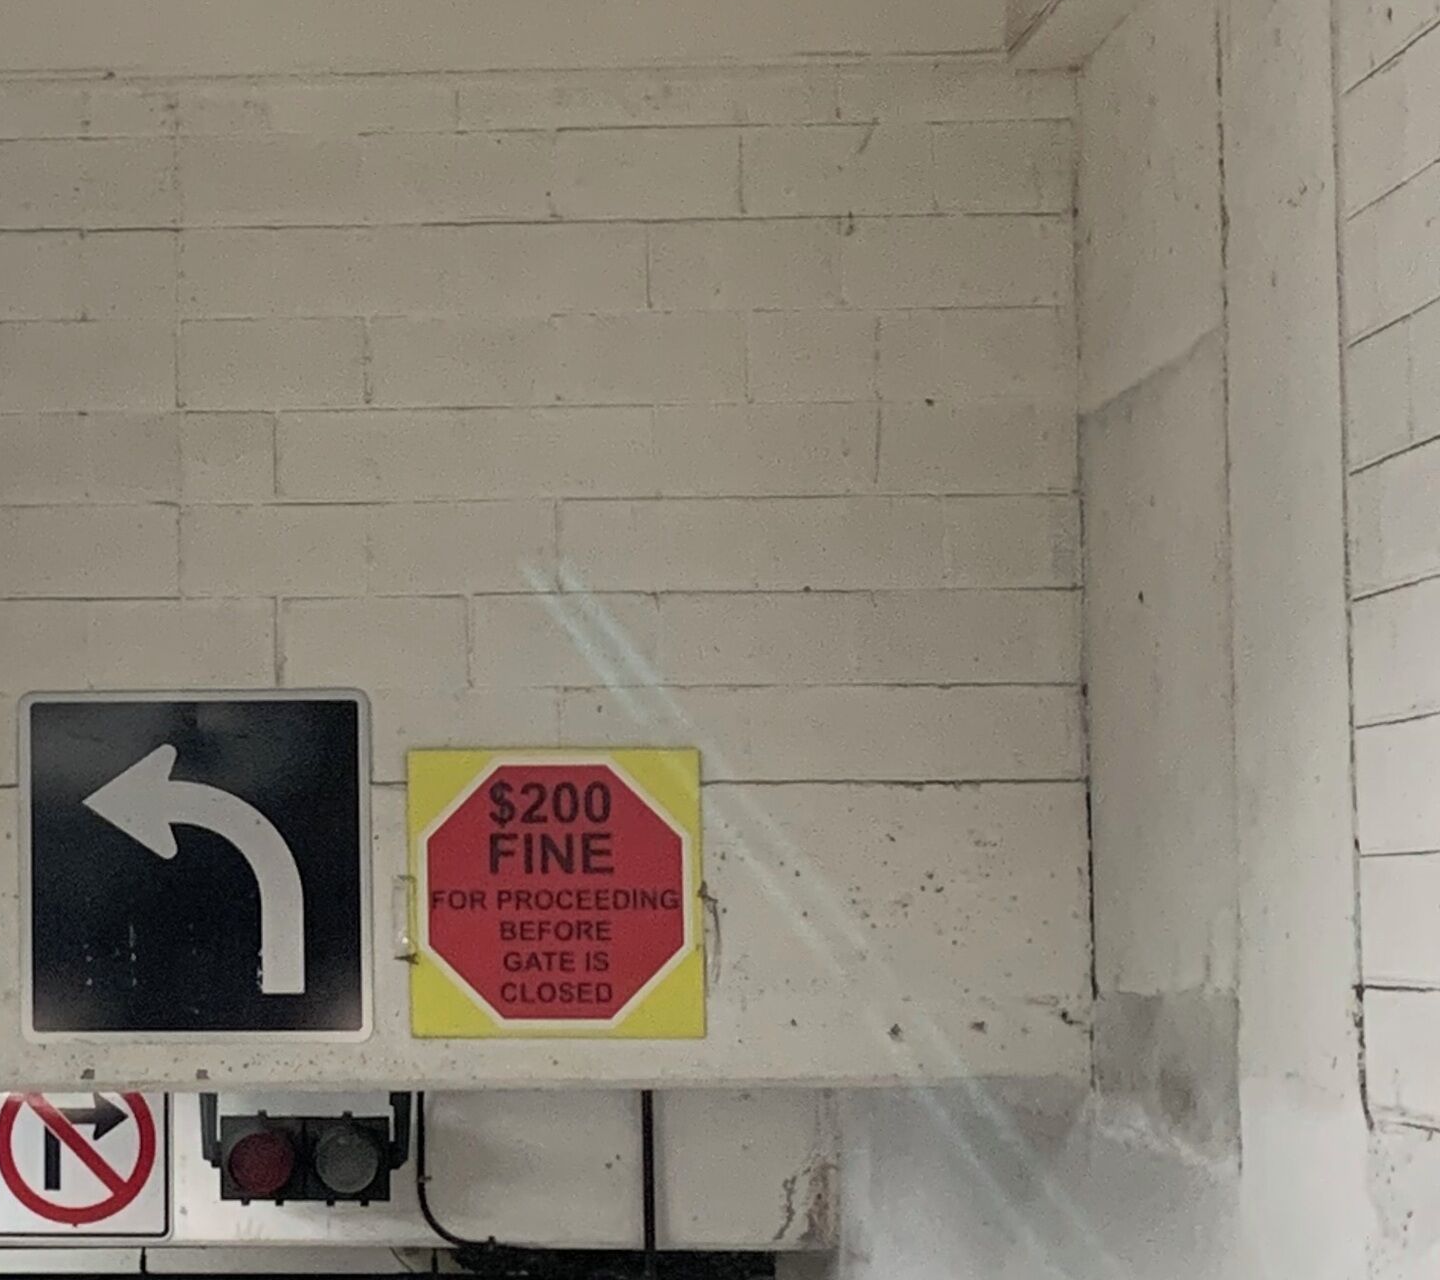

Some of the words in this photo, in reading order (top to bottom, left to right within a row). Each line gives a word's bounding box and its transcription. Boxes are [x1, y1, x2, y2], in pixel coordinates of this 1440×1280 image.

[489, 779, 611, 828] $200
[489, 832, 614, 875] FINE
[432, 889, 487, 911] FOR
[498, 889, 679, 911] PROCEEDING
[500, 921, 612, 941] BEFORE
[503, 952, 576, 972] GATE
[586, 952, 609, 972] IS
[501, 982, 612, 1004] CLOSED
